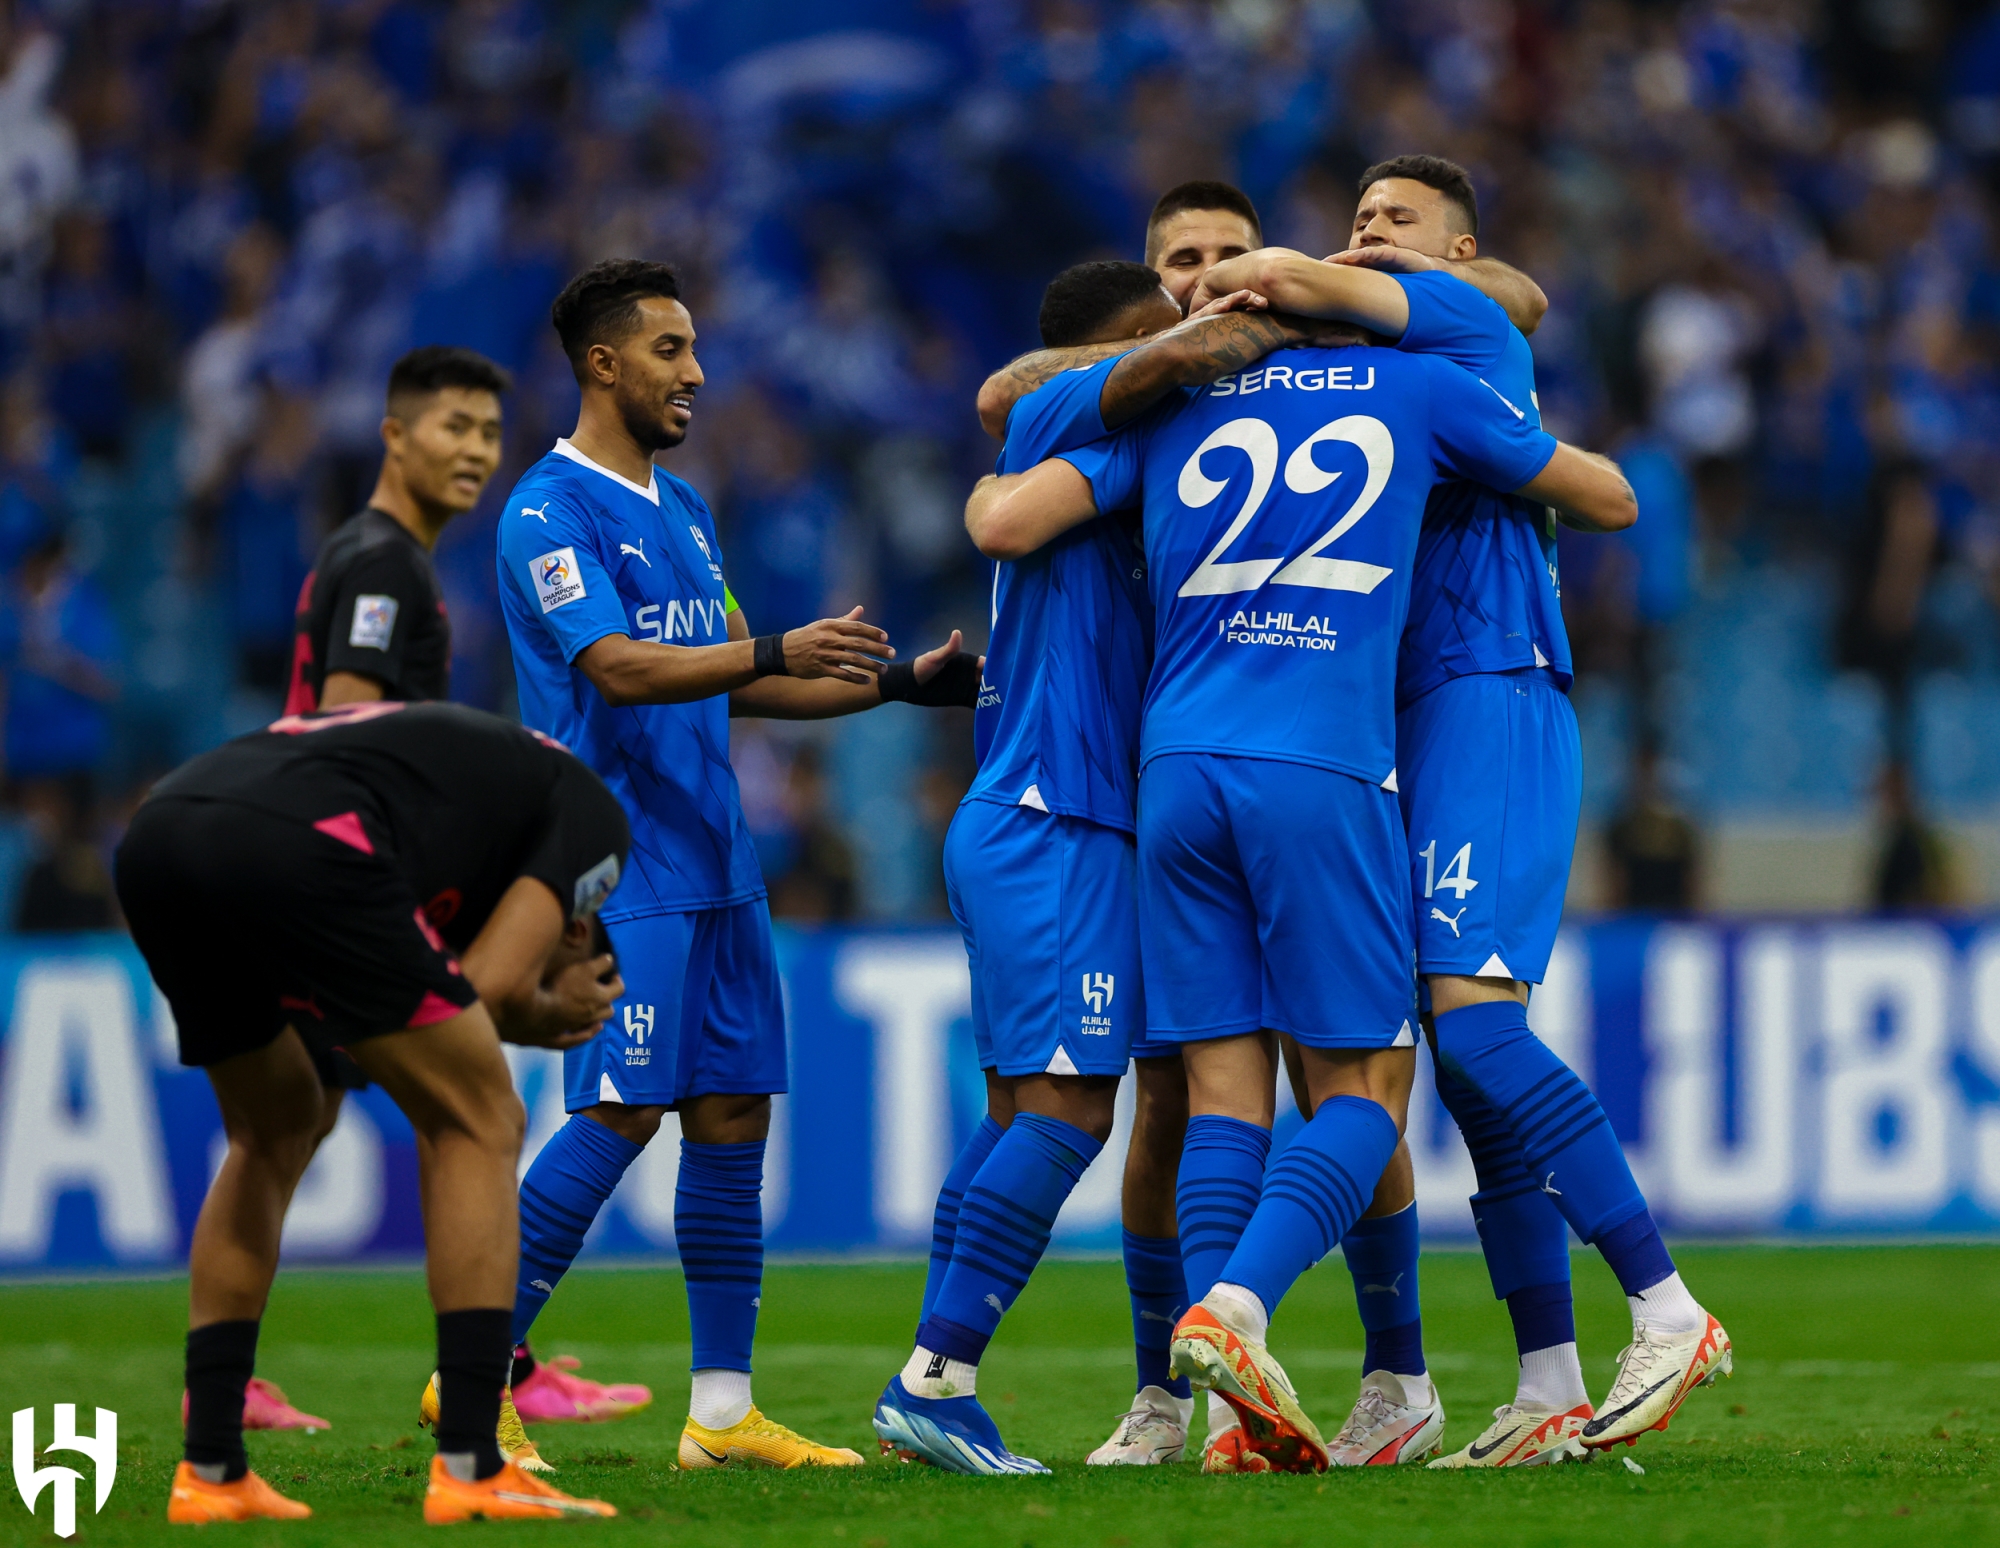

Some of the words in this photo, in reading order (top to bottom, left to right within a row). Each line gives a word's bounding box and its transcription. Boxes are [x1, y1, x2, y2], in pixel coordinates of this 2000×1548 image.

[1209, 366, 1375, 397] SERGEJ
[1177, 414, 1394, 598] 22
[542, 583, 581, 603] CHAMPIONS
[550, 591, 576, 606] LEAGUE
[1228, 610, 1338, 636] ALHILAL
[1226, 631, 1337, 652] FOUNDATION
[1418, 839, 1479, 900] 14
[1081, 1015, 1112, 1027] ALHILAL
[624, 1046, 652, 1056] ALHILAL
